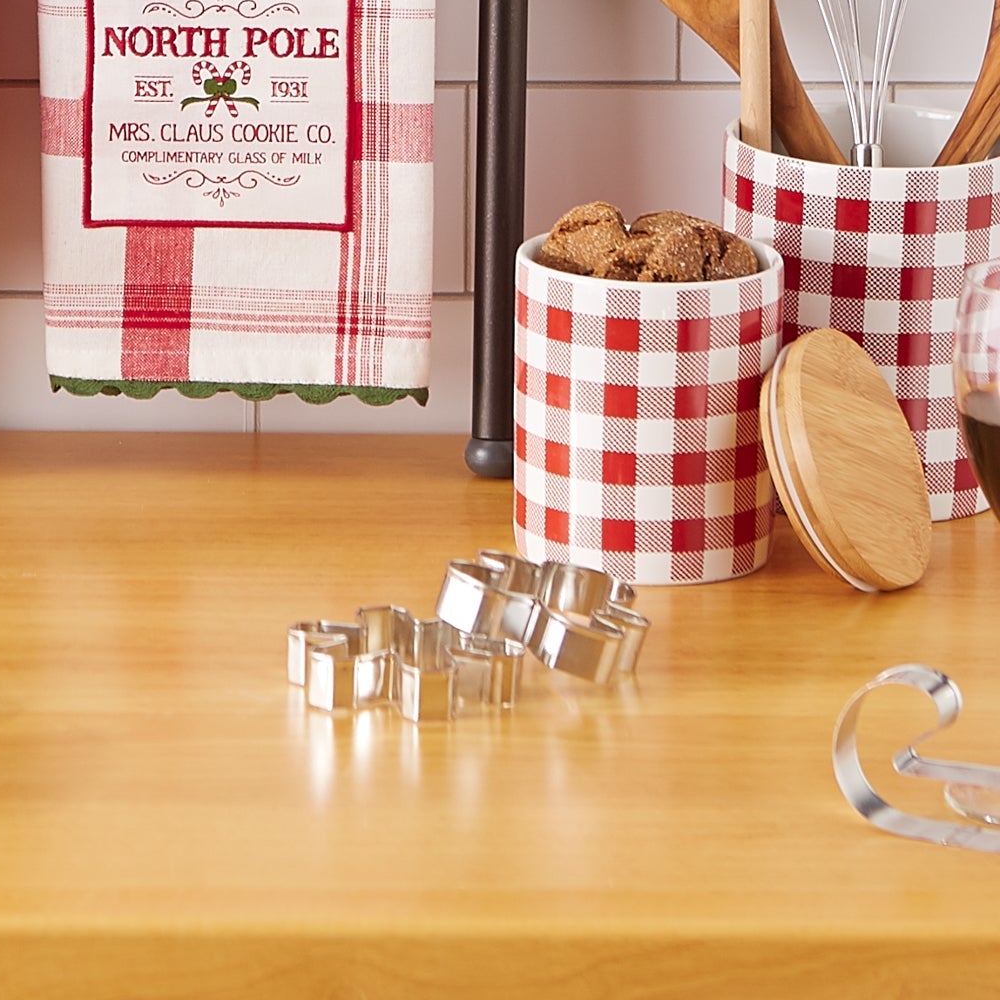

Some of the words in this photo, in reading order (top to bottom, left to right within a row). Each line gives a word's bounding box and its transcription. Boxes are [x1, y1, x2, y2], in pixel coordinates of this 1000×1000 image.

[101, 25, 230, 58] NORTH
[242, 27, 339, 58] POLE
[135, 80, 173, 97] EST.
[271, 81, 308, 97] 1931
[109, 123, 155, 141] MRS.
[161, 124, 223, 142] CLAUS
[232, 124, 298, 142] COOKIE
[307, 125, 335, 143] CO.
[122, 151, 223, 163] COMPLIMENTARY
[229, 152, 266, 164] GLASS
[271, 153, 286, 163] OF
[292, 153, 322, 164] MILK
